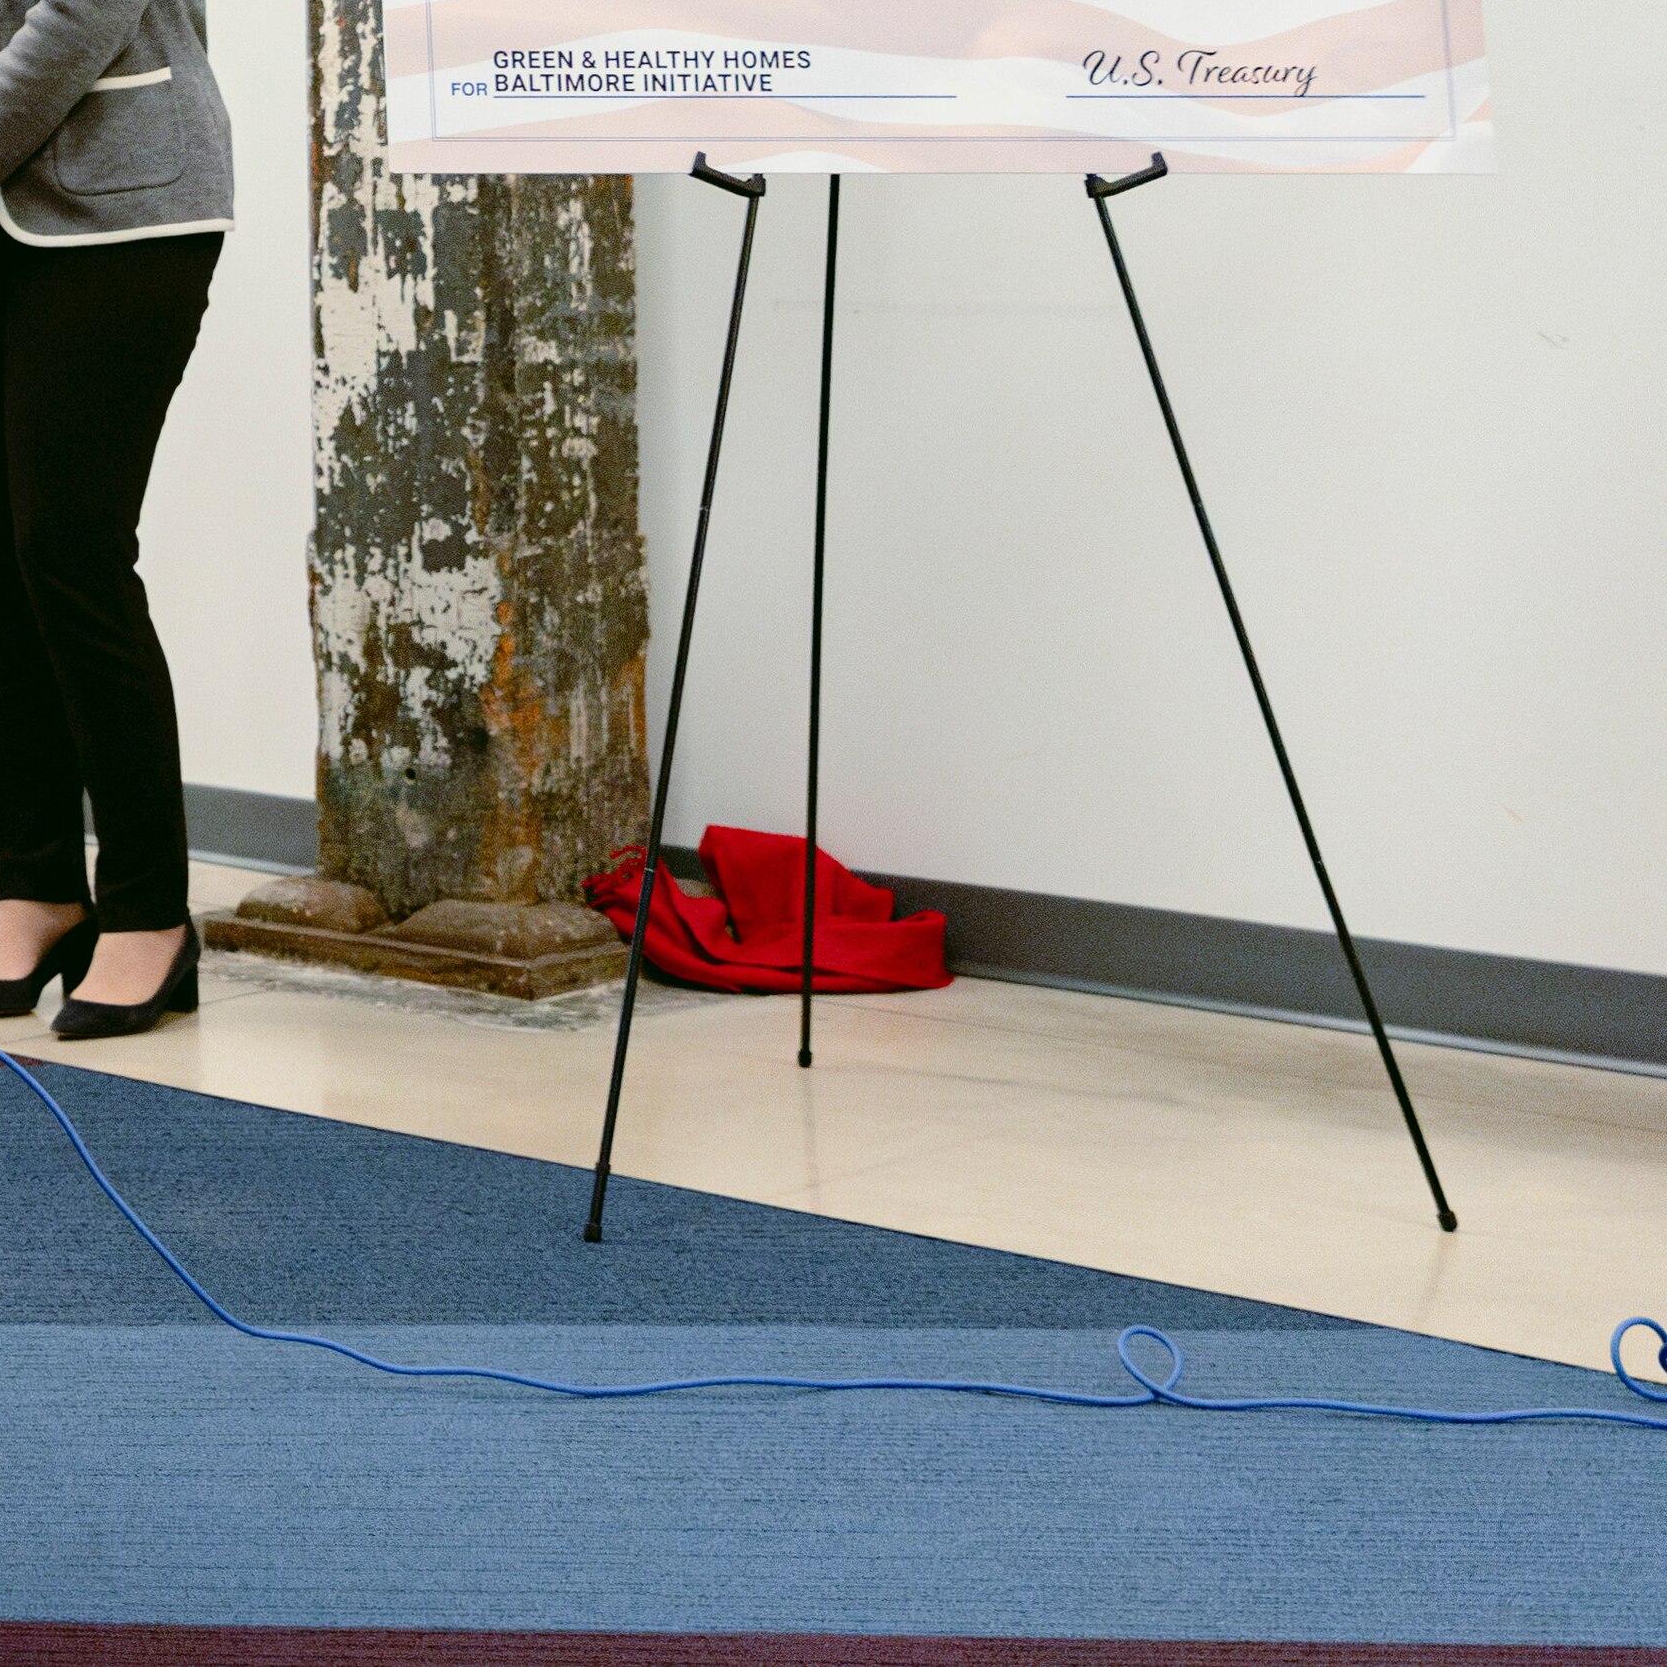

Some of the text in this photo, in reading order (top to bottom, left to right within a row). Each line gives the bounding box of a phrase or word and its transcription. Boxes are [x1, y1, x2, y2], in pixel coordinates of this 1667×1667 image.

[493, 50, 812, 69] GREEN & HEALTHY HOMES
[494, 73, 773, 92] BALTIMORE INITIATIVE
[1082, 50, 1318, 97] U.S. Treasury
[451, 81, 488, 97] FOR
